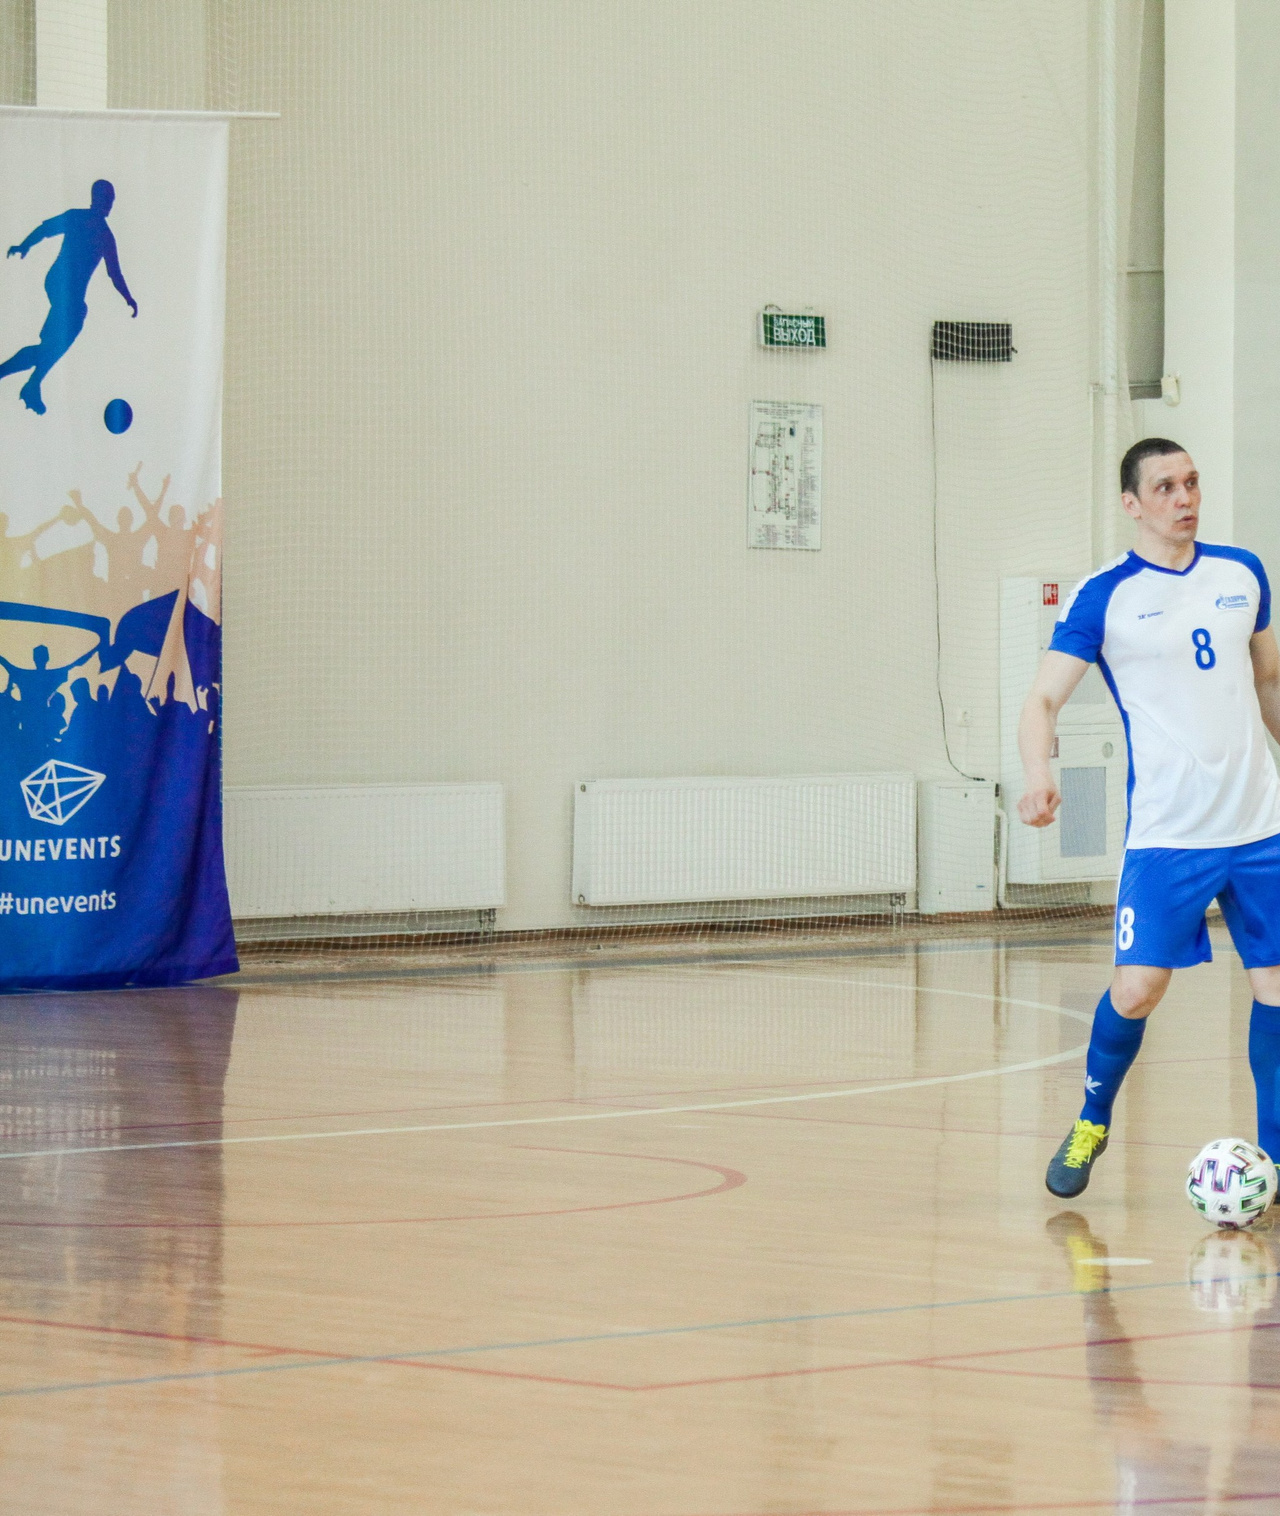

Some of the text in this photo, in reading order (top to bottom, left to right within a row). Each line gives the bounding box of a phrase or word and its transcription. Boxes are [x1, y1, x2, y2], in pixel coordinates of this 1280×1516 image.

[773, 328, 816, 346] ВЫХОД
[1191, 628, 1216, 671] 8
[0, 835, 121, 862] UNEVENTS
[0, 889, 117, 915] #unevents
[1118, 907, 1135, 951] 8
